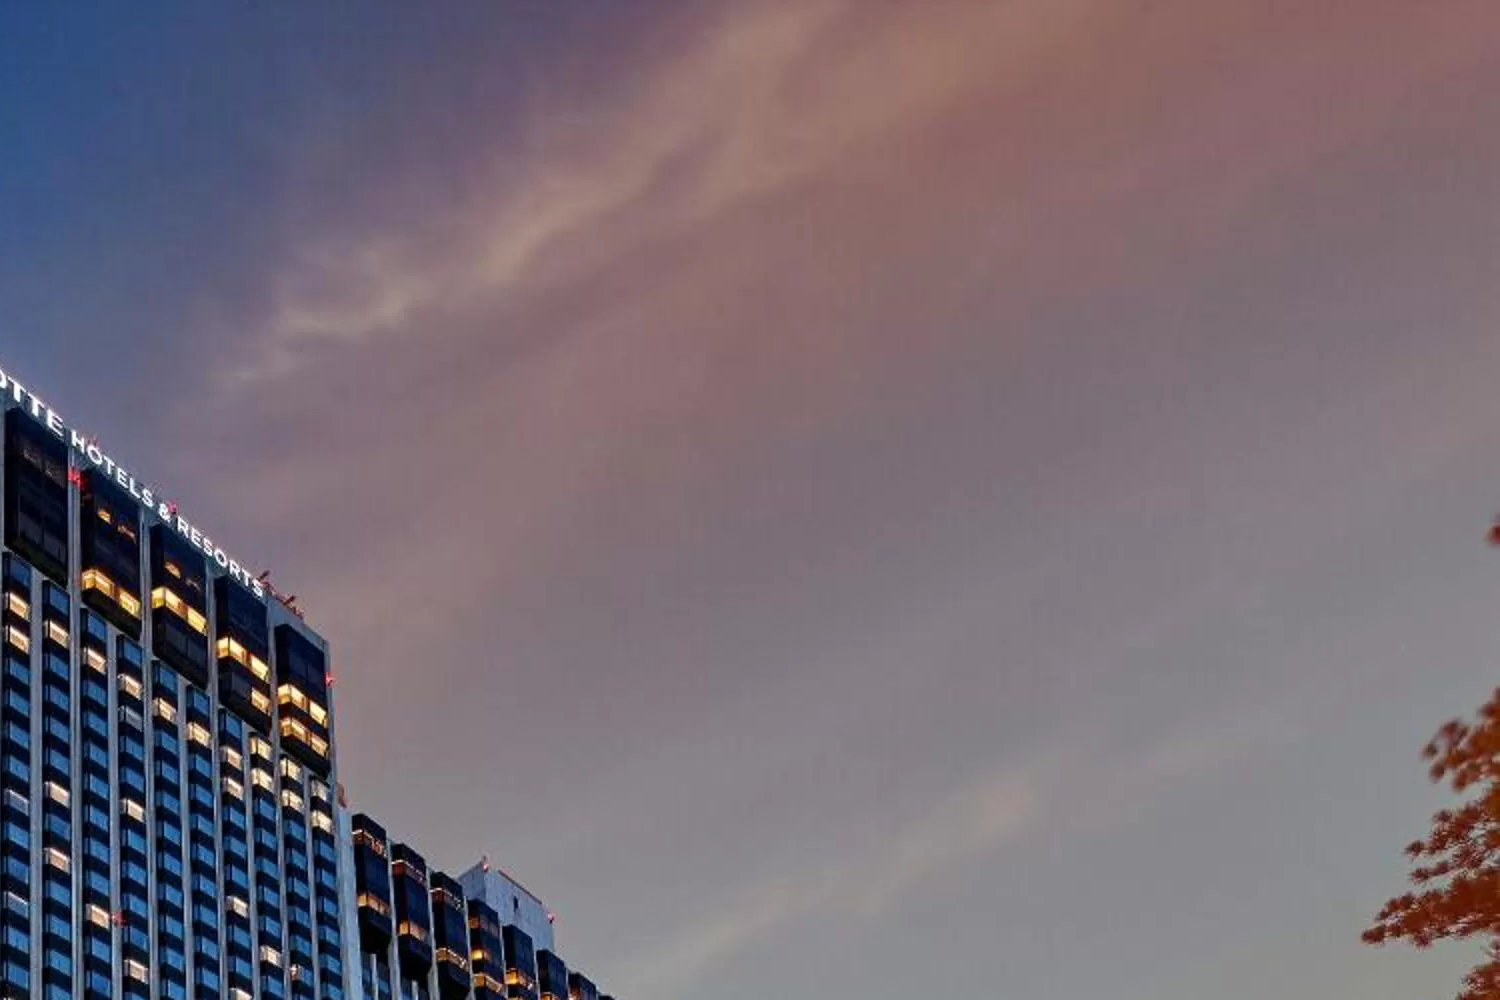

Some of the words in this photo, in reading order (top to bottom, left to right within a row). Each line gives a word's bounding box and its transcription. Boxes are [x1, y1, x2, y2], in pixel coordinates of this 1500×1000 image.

[71, 429, 154, 506] HOTELS
[158, 503, 173, 521] &
[176, 515, 264, 598] RESORTS
